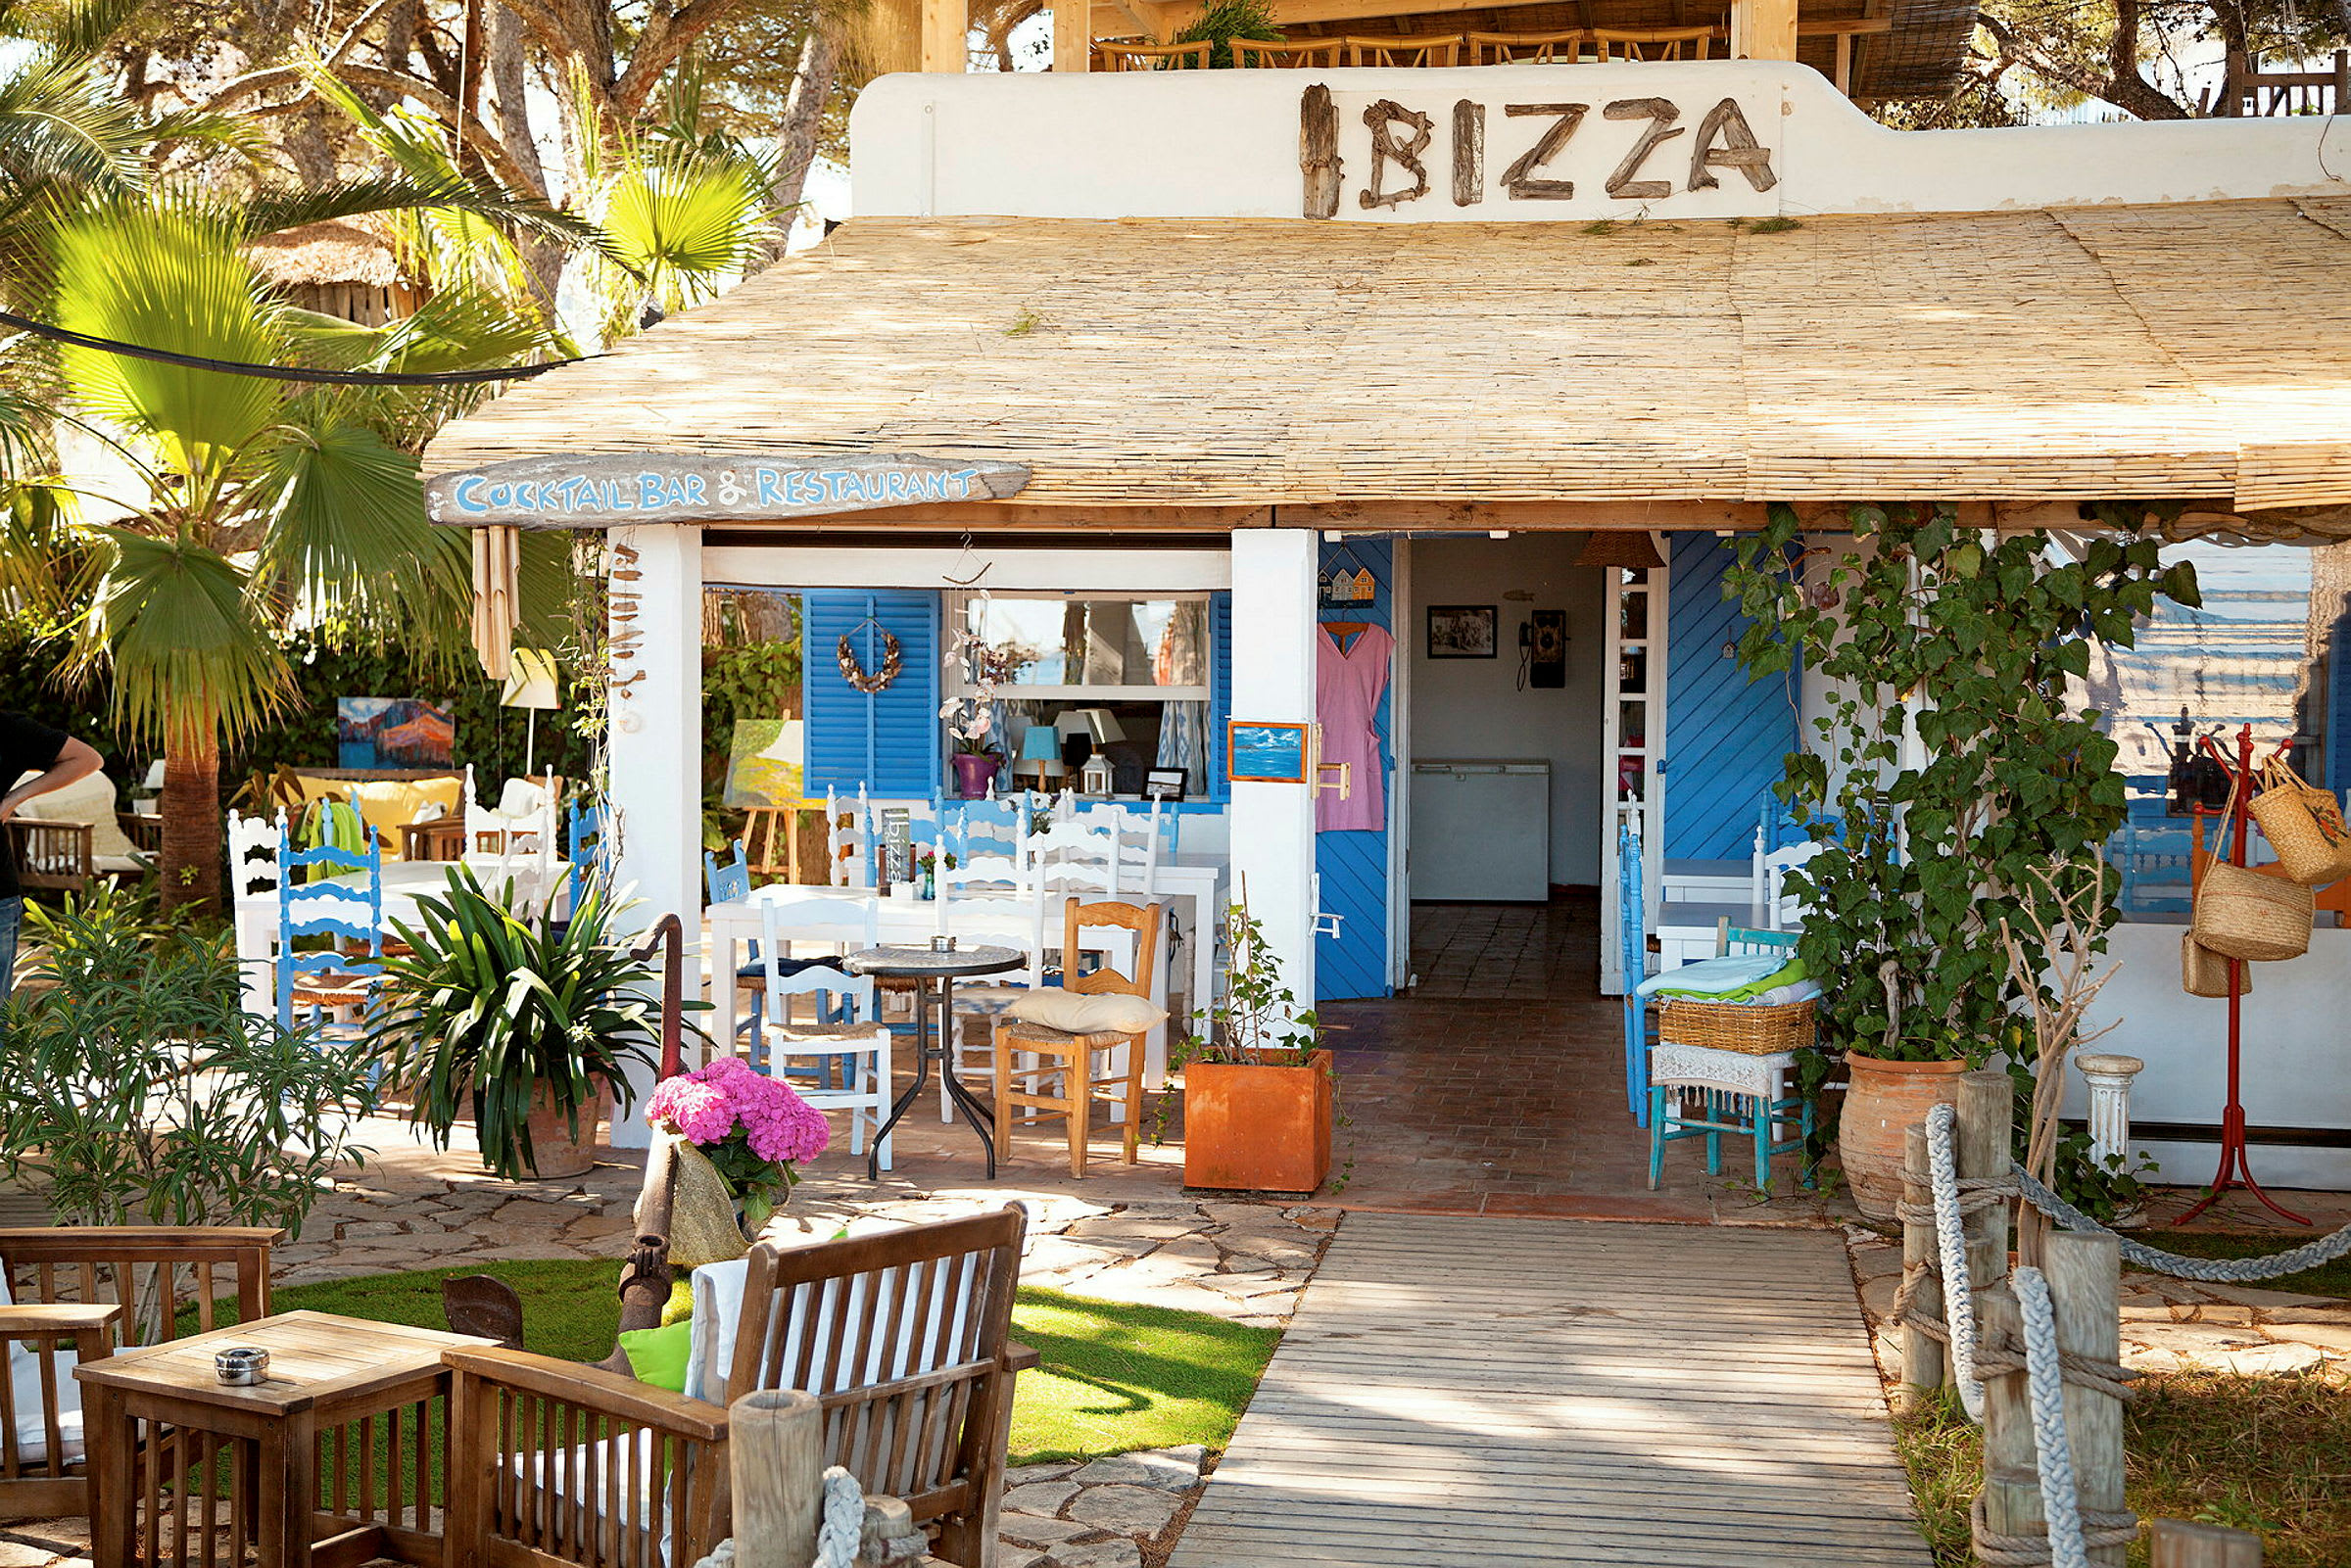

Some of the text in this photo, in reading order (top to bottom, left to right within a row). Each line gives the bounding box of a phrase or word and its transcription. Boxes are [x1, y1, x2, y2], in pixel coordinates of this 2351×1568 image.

[1300, 83, 1777, 220] IBIZZA
[456, 468, 978, 513] COCKTAIL BAR & RESTAURANT
[886, 813, 909, 883] Ibizza
